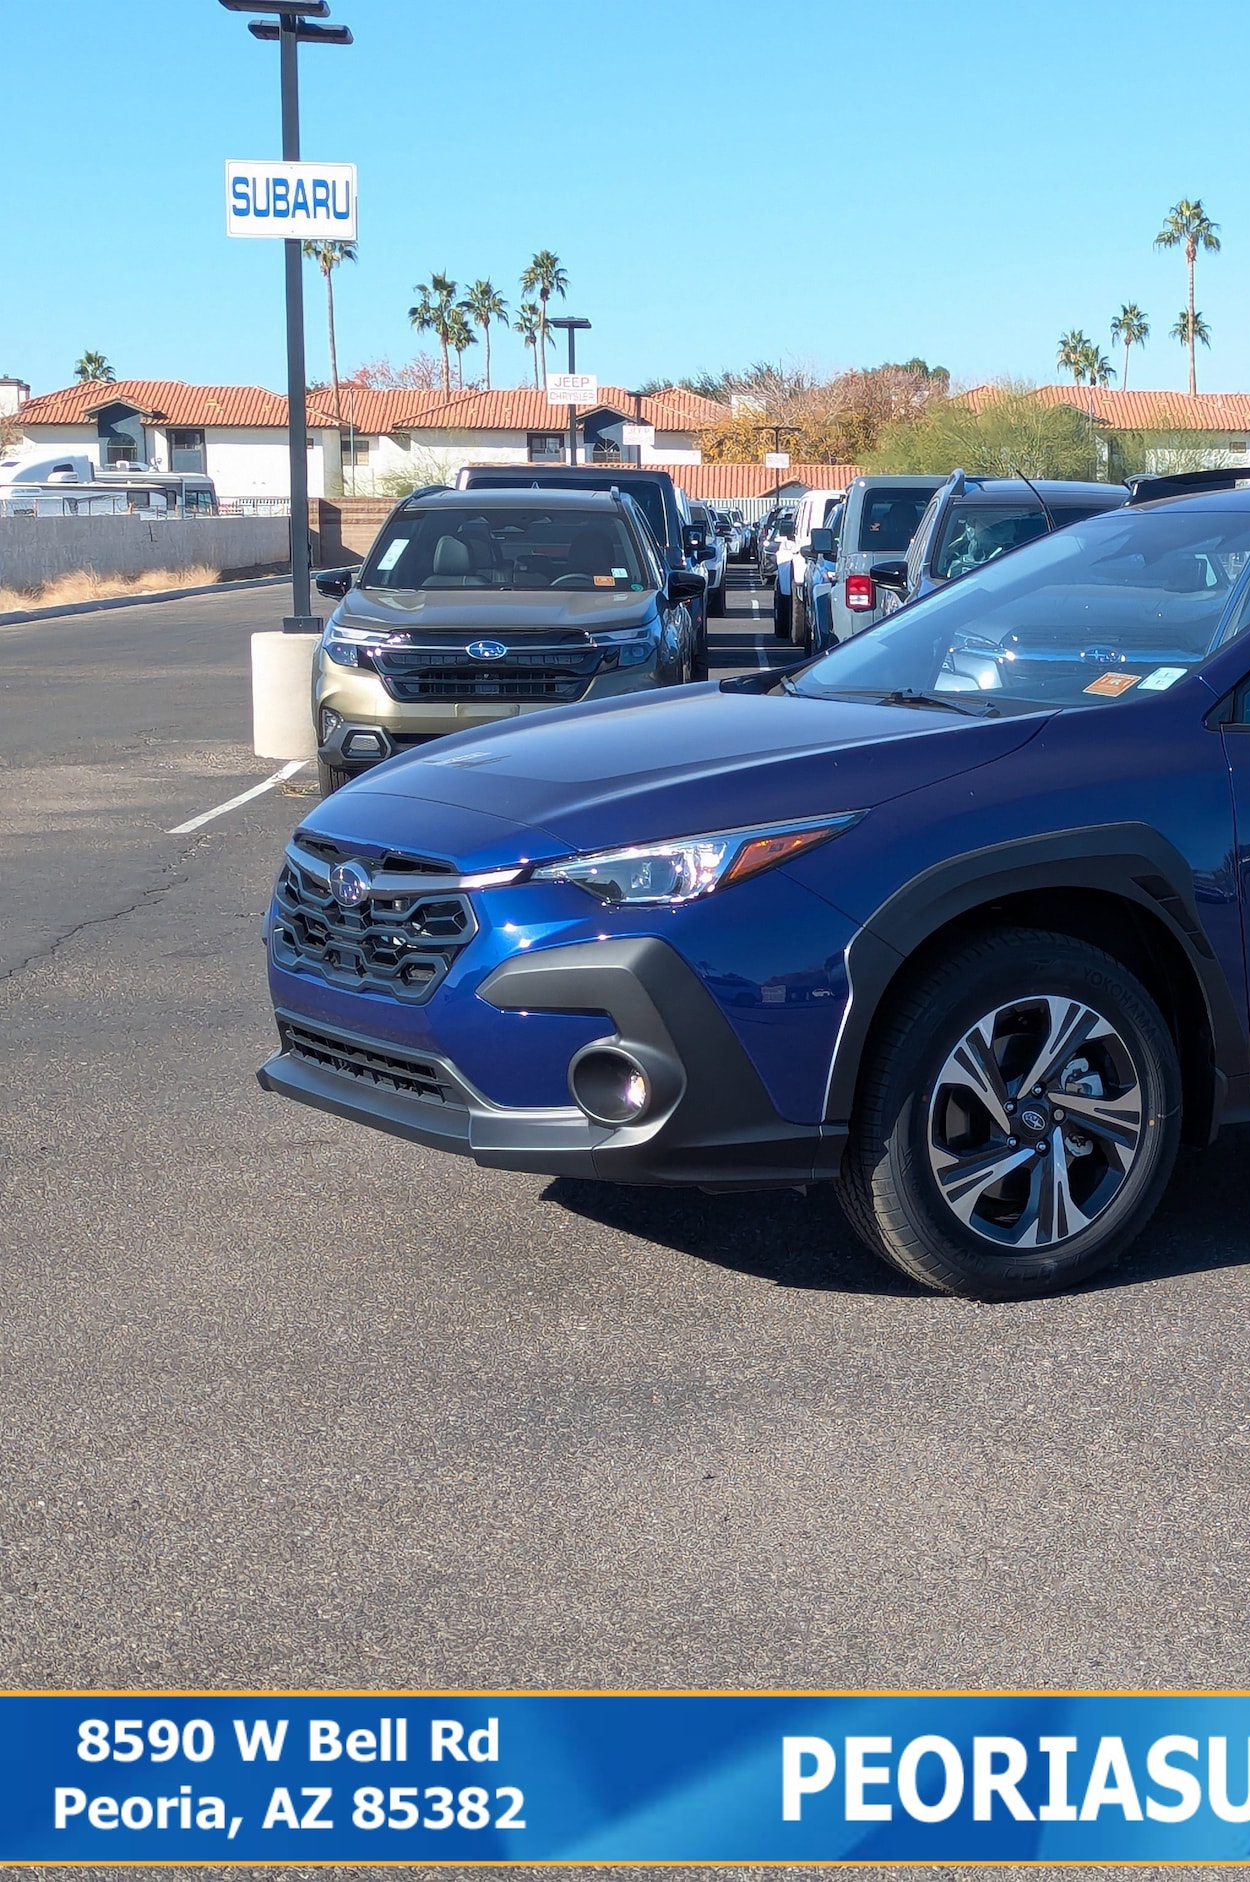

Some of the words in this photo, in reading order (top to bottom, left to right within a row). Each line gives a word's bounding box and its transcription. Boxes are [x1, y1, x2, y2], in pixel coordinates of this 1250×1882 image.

[231, 176, 350, 220] SUBARU
[549, 390, 595, 402] CHRYSLER
[554, 376, 590, 388] JEEP
[1083, 966, 1158, 1042] YOKOHAMA
